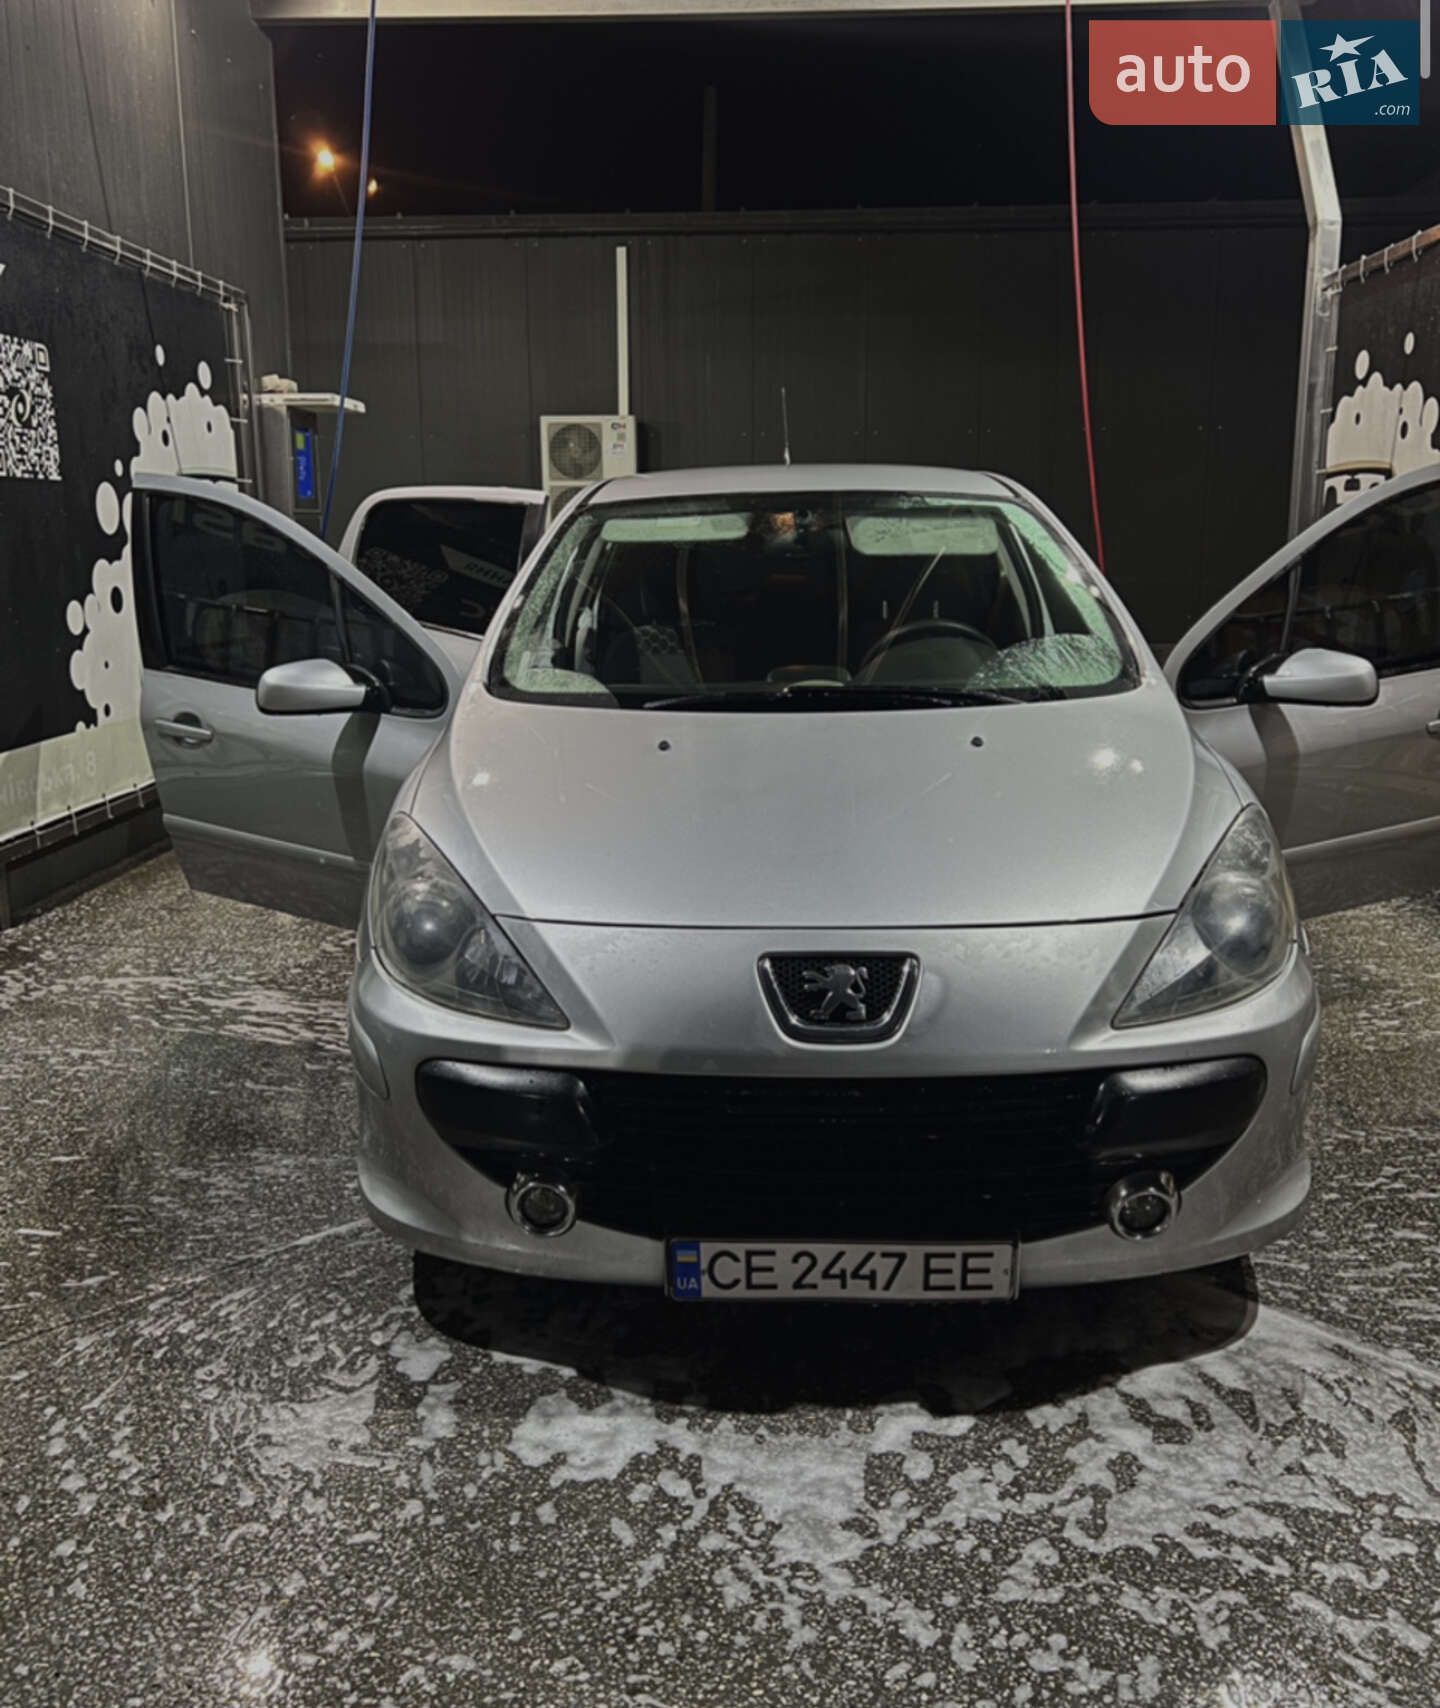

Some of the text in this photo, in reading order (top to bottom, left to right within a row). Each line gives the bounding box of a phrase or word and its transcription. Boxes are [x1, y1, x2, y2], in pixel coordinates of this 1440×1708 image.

[677, 1277, 698, 1290] UA
[707, 1249, 995, 1292] CE 2447 EE
